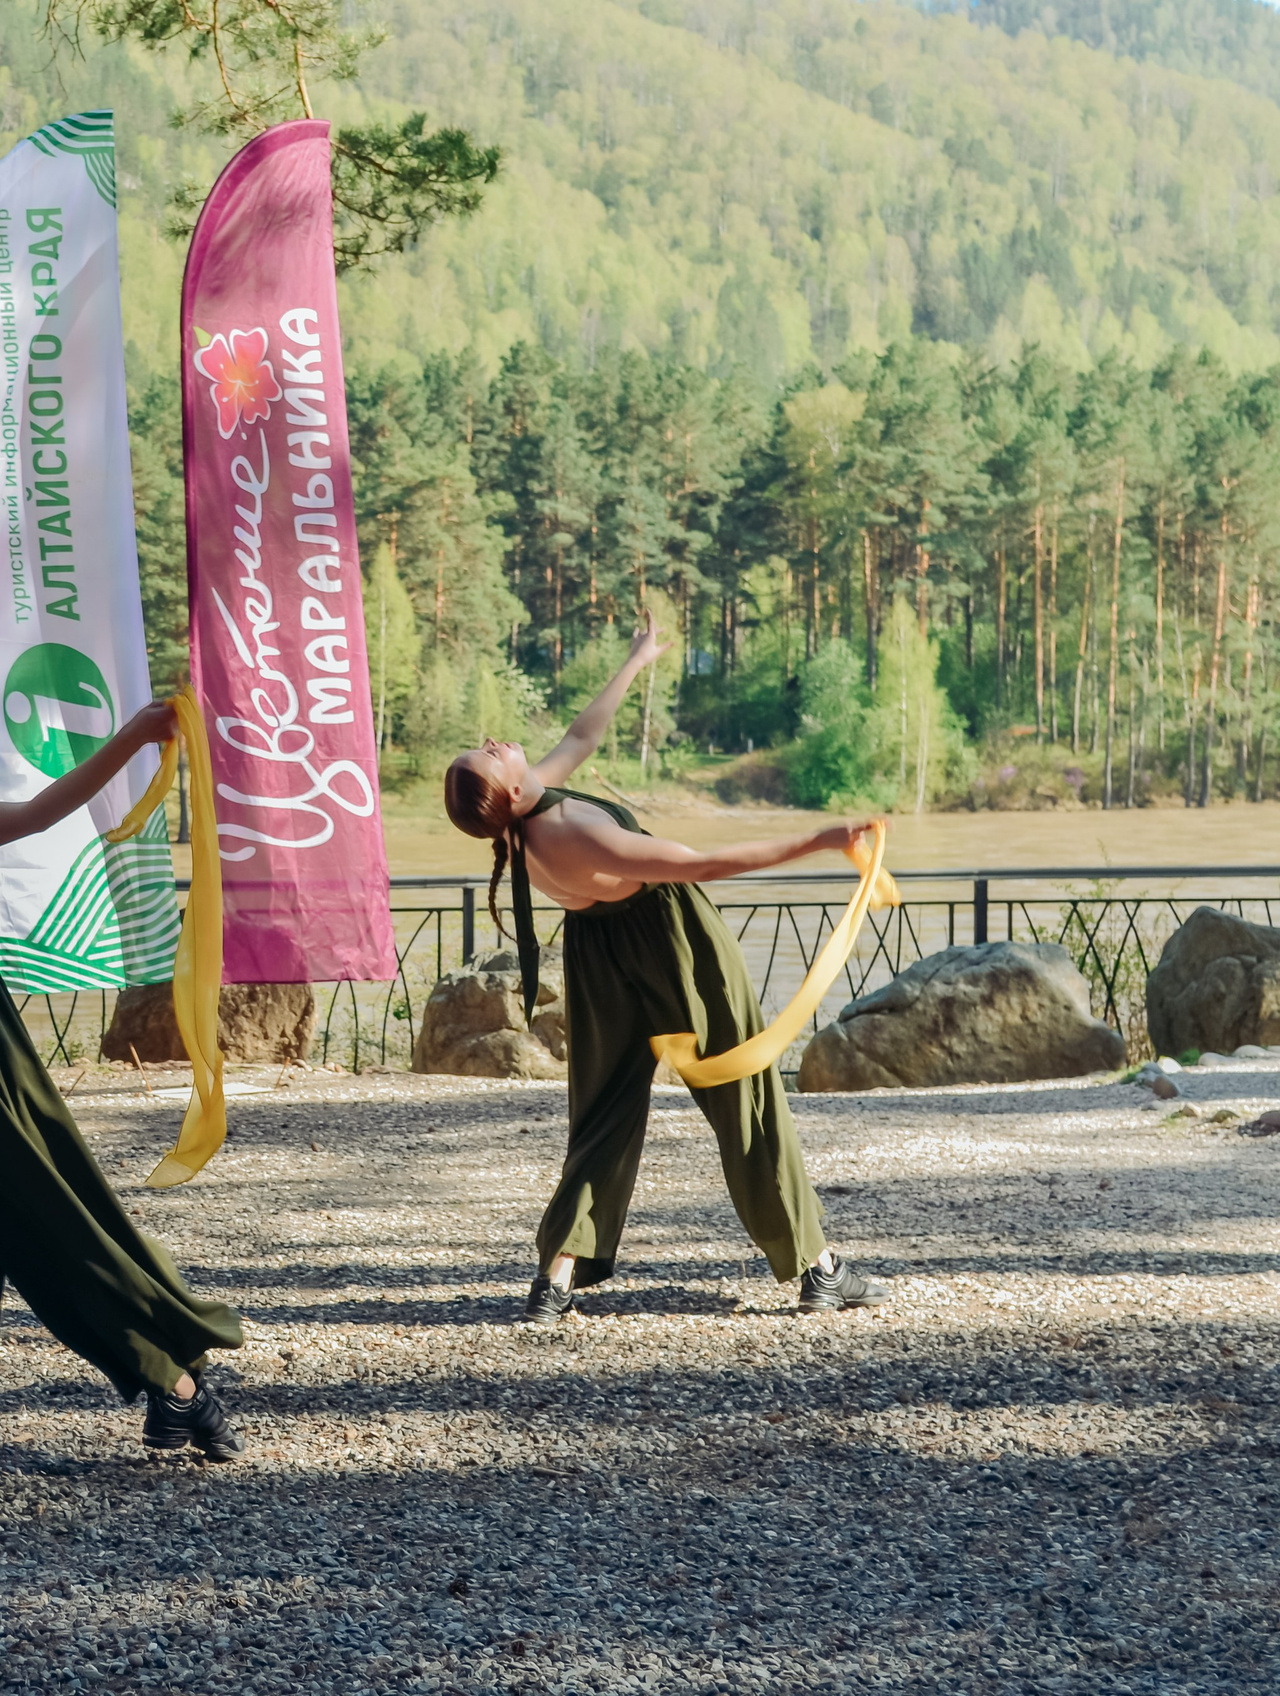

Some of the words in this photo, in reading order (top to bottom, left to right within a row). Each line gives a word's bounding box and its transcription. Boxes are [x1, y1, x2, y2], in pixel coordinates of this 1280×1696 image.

[26, 207, 63, 317] КРАЯ
[0, 498, 32, 625] туристский
[26, 333, 81, 623] АЛТАЙСКОГО
[279, 307, 355, 724] МАРАЛЬНИКА
[211, 427, 375, 862] Цветение
